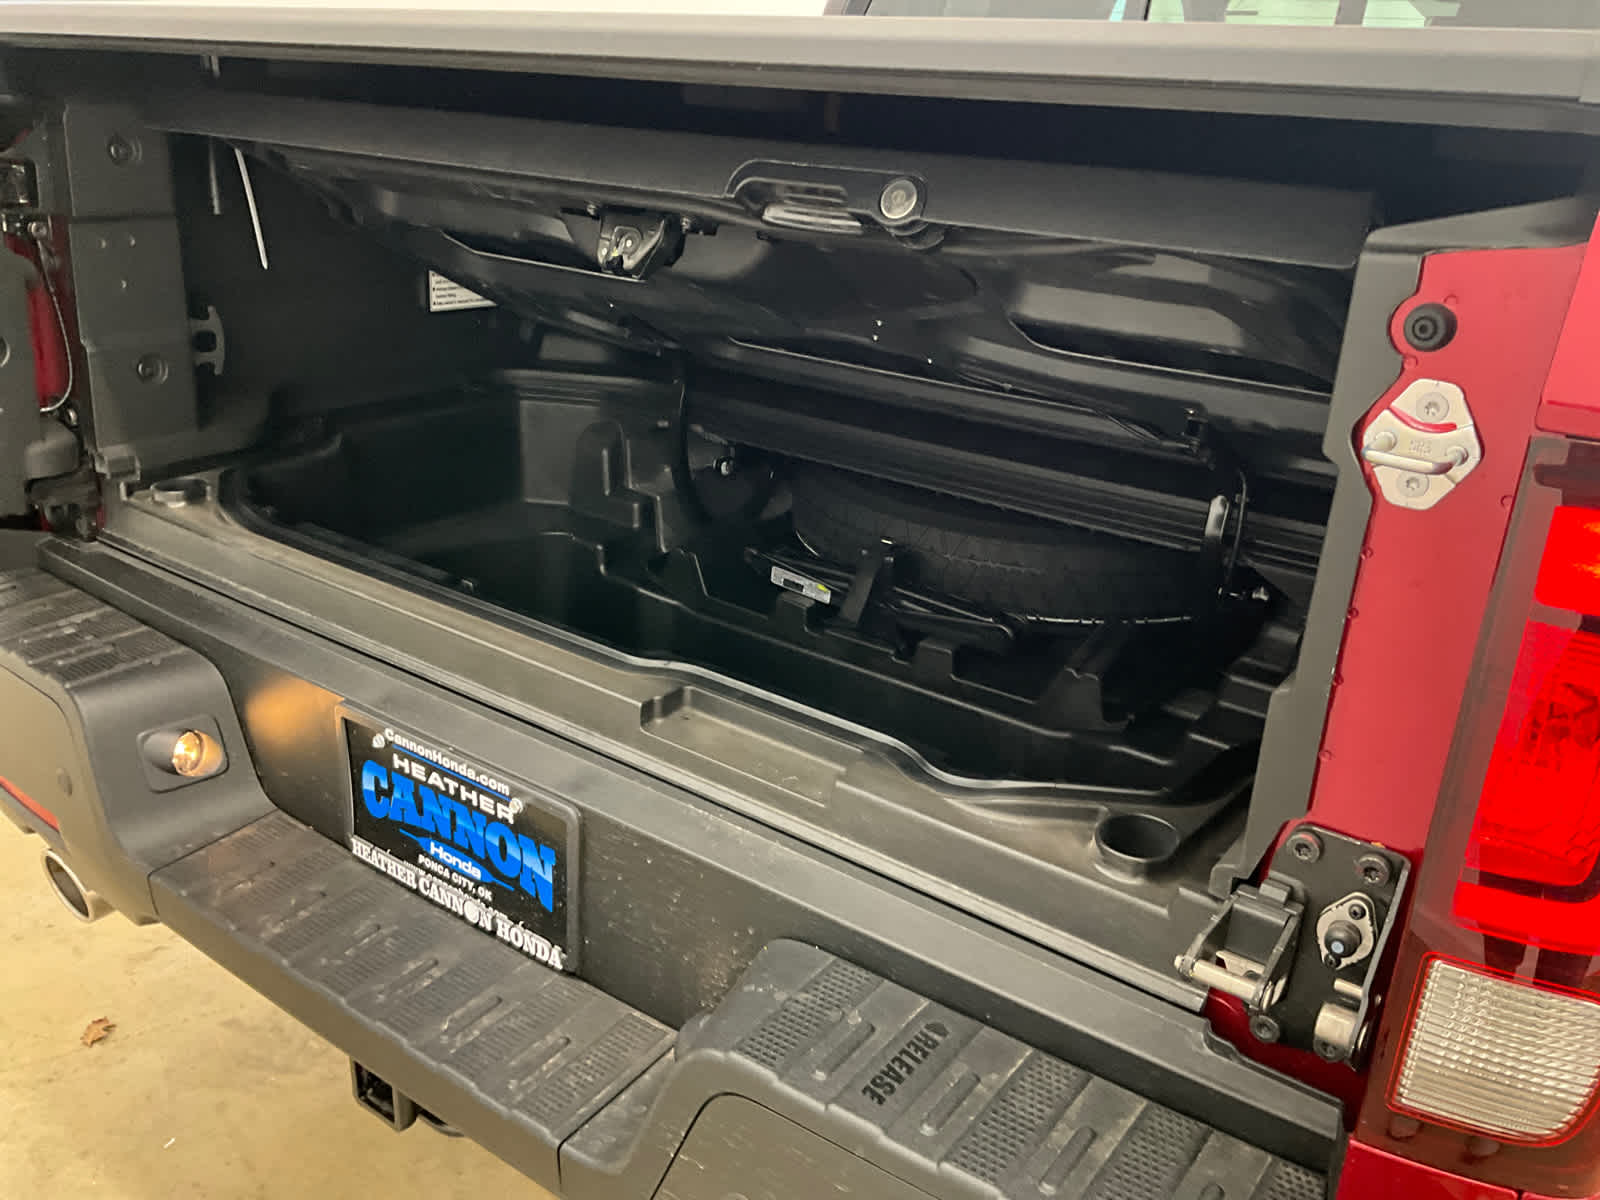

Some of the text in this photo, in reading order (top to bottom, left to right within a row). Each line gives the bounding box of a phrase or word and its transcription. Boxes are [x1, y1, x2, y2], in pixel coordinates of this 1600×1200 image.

[384, 727, 510, 796] CannonHonda.com
[392, 752, 514, 825] HEATHER
[362, 760, 556, 912] CANNON
[430, 841, 482, 881] Honda
[351, 837, 417, 890] HEATHER
[418, 877, 493, 932] CANNON
[495, 917, 563, 970] HONDA
[418, 853, 493, 902] PONCA CITY, OK
[861, 1029, 940, 1106] RELEASE
